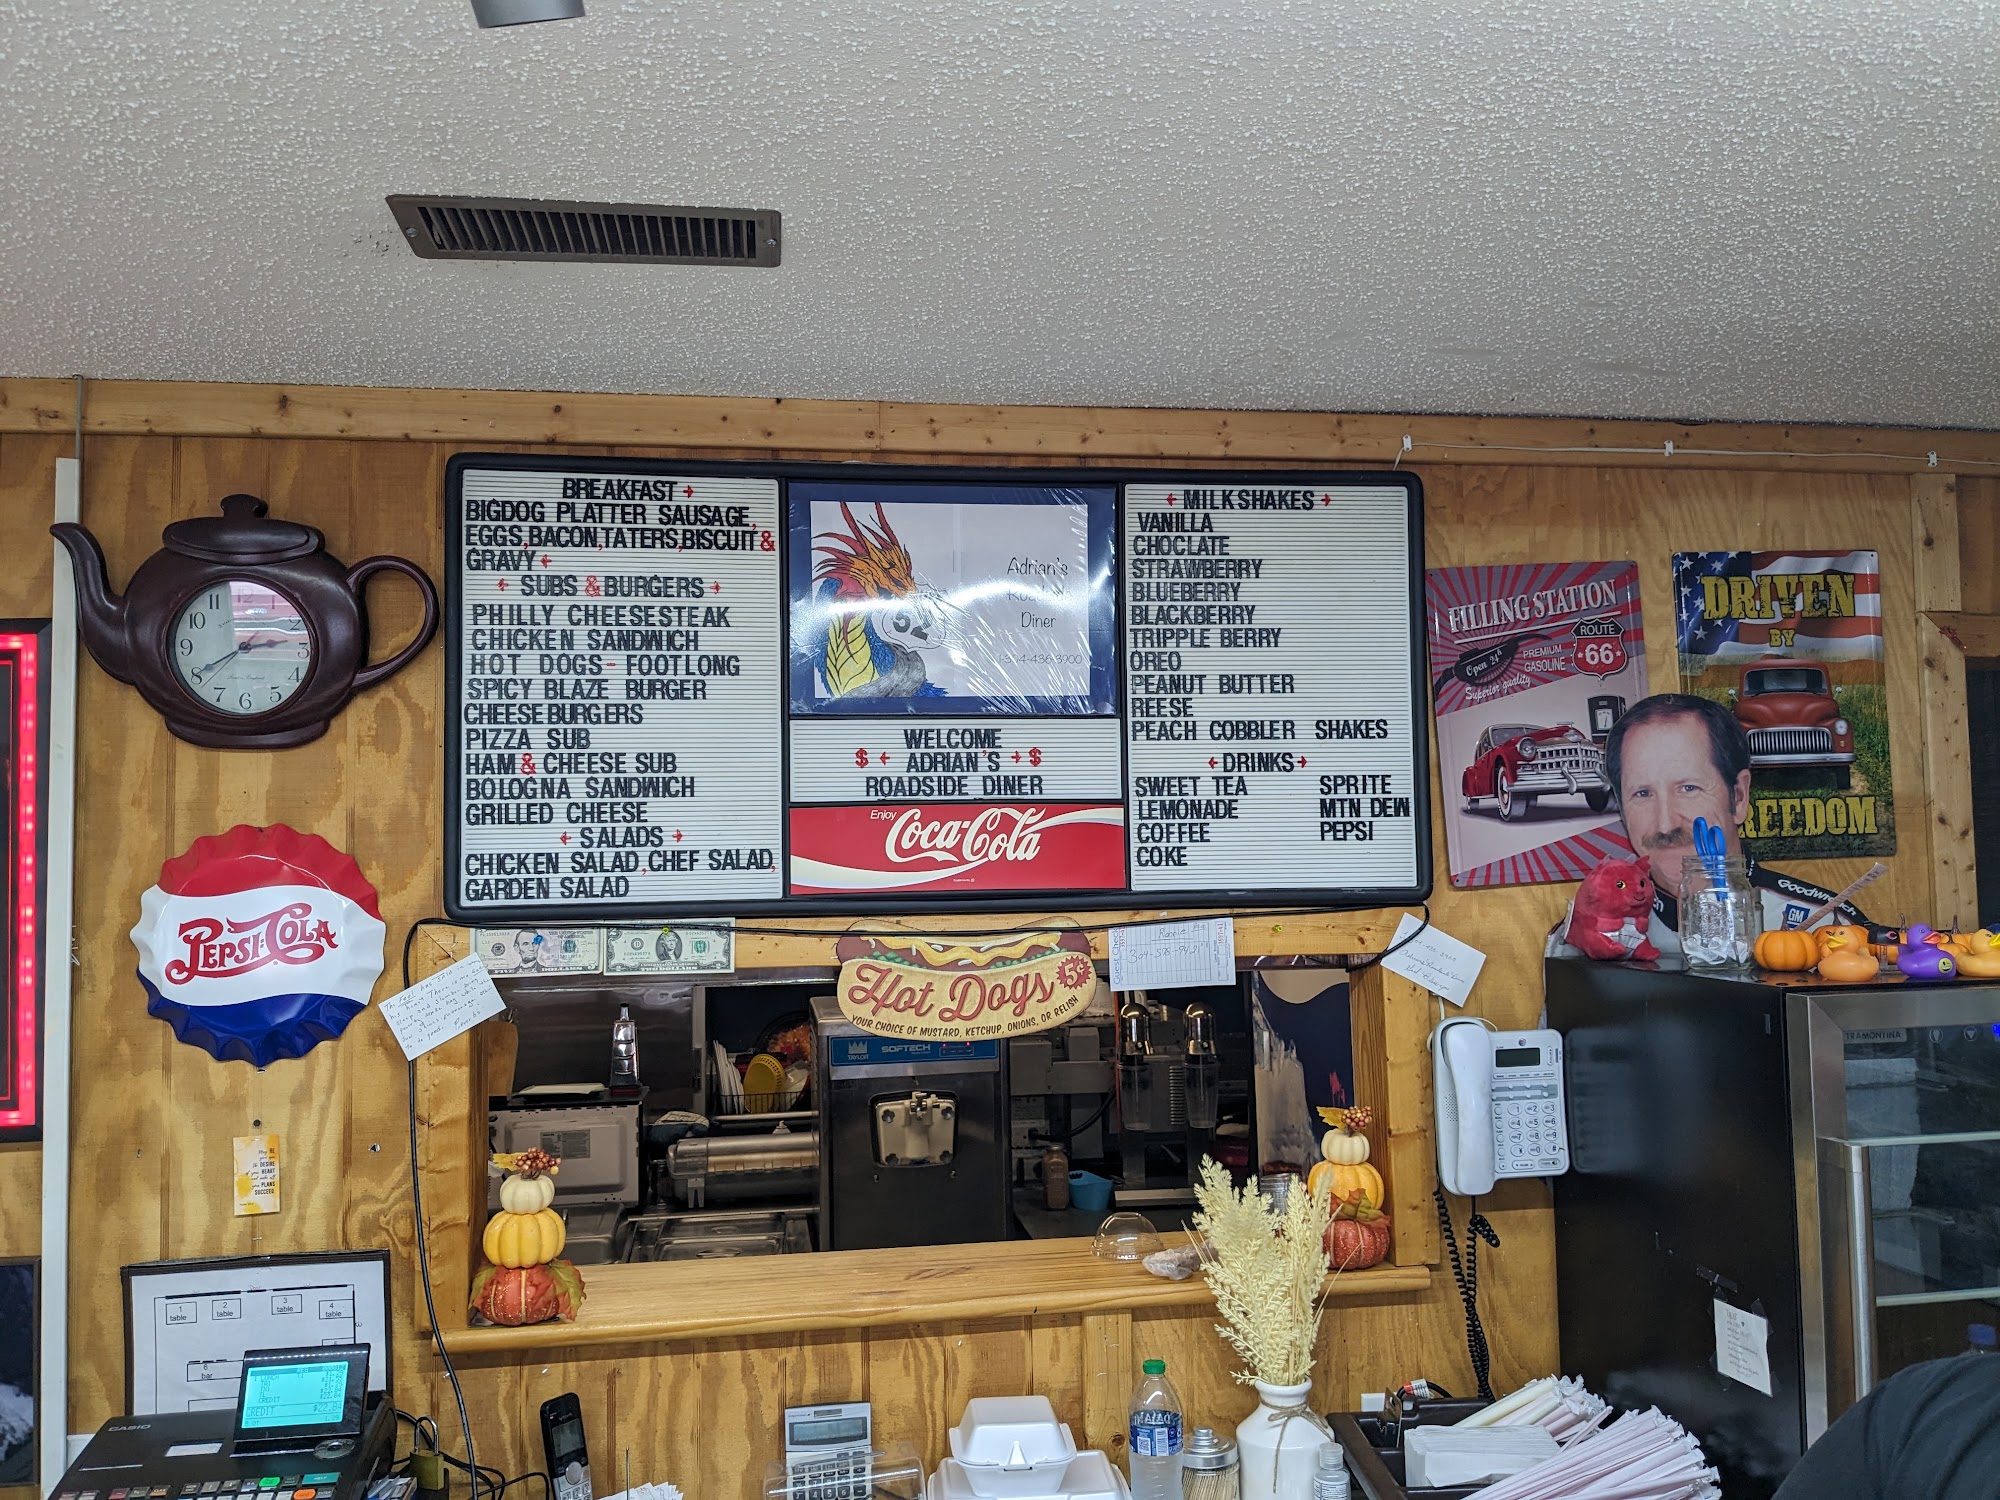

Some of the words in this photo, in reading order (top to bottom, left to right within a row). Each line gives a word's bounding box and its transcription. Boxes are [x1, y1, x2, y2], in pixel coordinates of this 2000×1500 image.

[563, 478, 677, 501] BREAKFAST
[1183, 490, 1315, 510] MILKSHAKES
[466, 499, 545, 522] BIGDOG
[557, 502, 646, 524] PLATTER
[658, 505, 757, 530] SAUSAGE,
[1138, 512, 1213, 532] VANILLA
[760, 530, 775, 552] &
[1133, 536, 1230, 556] CHOCLATE
[466, 549, 536, 571] GRAVY
[1007, 557, 1068, 576] Adrian's
[1132, 559, 1262, 579] STRAWBERRY
[521, 574, 578, 596] SUBS
[585, 575, 600, 597] &
[604, 575, 704, 598] BURGERS
[1132, 582, 1241, 602] BLUEBERRY
[209, 594, 219, 609] 11
[1448, 594, 1530, 633] FILLING
[1533, 579, 1617, 618] STATION
[1701, 574, 1855, 620] DRIVEN
[189, 612, 205, 629] 10
[472, 604, 554, 626] PHILLY
[568, 604, 731, 627] CHEESESTEAK
[1021, 611, 1056, 628] Diner
[1131, 605, 1256, 625] BLACKBERRY
[471, 628, 574, 651] CHICKEN
[587, 629, 698, 651] SANDWICH
[1130, 628, 1210, 648] TRIPPLE
[1220, 628, 1281, 648] BERRY
[1580, 624, 1614, 635] ROUTE
[1769, 628, 1795, 647] BY
[180, 639, 193, 656] 9
[298, 643, 310, 658] 3
[1523, 644, 1562, 659] PREMIUM
[1585, 643, 1614, 665] 66
[471, 653, 521, 676] HOT
[626, 655, 740, 676] FOOTLONG
[1130, 650, 1181, 671] OREO
[1466, 660, 1488, 677] Open
[1524, 657, 1566, 673] GASOLINE
[191, 667, 202, 685] 8
[288, 667, 302, 682] 4
[1131, 674, 1206, 694] PEANUT
[1219, 674, 1295, 694] BUTTER
[214, 687, 226, 702] 7
[270, 686, 282, 702] 5
[467, 678, 533, 700] SPICY
[544, 679, 609, 700] BLAZE
[626, 680, 707, 701] BURGER
[1466, 682, 1501, 702] Superior
[1503, 674, 1531, 690] quality
[239, 693, 252, 710] 6
[1131, 698, 1193, 718] REESE
[466, 728, 531, 750] PIZZA
[547, 728, 591, 749] SUB
[904, 728, 1002, 749] WELCOME
[1131, 720, 1197, 741] PEACH
[1210, 720, 1295, 741] COBBLER
[1315, 719, 1388, 740] SHAKES
[466, 753, 516, 775] HAM
[520, 752, 537, 775] &
[544, 752, 626, 774] CHEESE
[635, 752, 677, 774] SUB
[906, 750, 1000, 773] ADRIAN'S
[1223, 752, 1294, 772] DRINKS
[466, 777, 571, 799] BOLOGNA
[585, 776, 694, 798] SANDWICH
[865, 775, 969, 797] ROADSIDE
[982, 775, 1043, 795] DINER
[1135, 777, 1200, 797] SWEET
[1212, 776, 1248, 796] TEA
[1320, 774, 1392, 794] SPRITE
[466, 803, 553, 825] GRILLED
[567, 802, 647, 823] CHEESE
[870, 810, 897, 821] Enjoy
[1138, 799, 1239, 820] LEMONADE
[1320, 798, 1360, 818] MTN
[1371, 798, 1410, 818] DEW
[1738, 796, 1878, 839] REEDOM
[579, 826, 663, 848] SALADS
[885, 806, 1047, 862] Coca-Cola
[1137, 822, 1210, 843] COFFEE
[1320, 821, 1373, 841] PEPSI
[465, 853, 559, 875] CHICKEN
[1136, 846, 1188, 867] COKE
[465, 877, 549, 900] GARDEN
[560, 876, 630, 898] SALAD
[1788, 908, 1803, 922] GM
[1112, 927, 1121, 956] Check
[1113, 958, 1121, 985] Guest
[847, 963, 934, 1017] Hot
[938, 972, 1054, 1023] Dogs
[850, 1014, 873, 1028] YOUR
[875, 1021, 904, 1034] CHOICE
[906, 1025, 917, 1035] OF
[920, 1026, 962, 1038] MUSTARD,
[965, 1024, 1005, 1036] KETCHUP,
[1007, 1018, 1039, 1032] ONIONS,
[1041, 1011, 1052, 1023] OR
[1054, 995, 1079, 1018] RELISH
[881, 1043, 931, 1053] SOFTECH
[277, 1305, 294, 1313] table
[246, 1407, 275, 1417] CREDIT
[313, 1403, 341, 1412] $22.84
